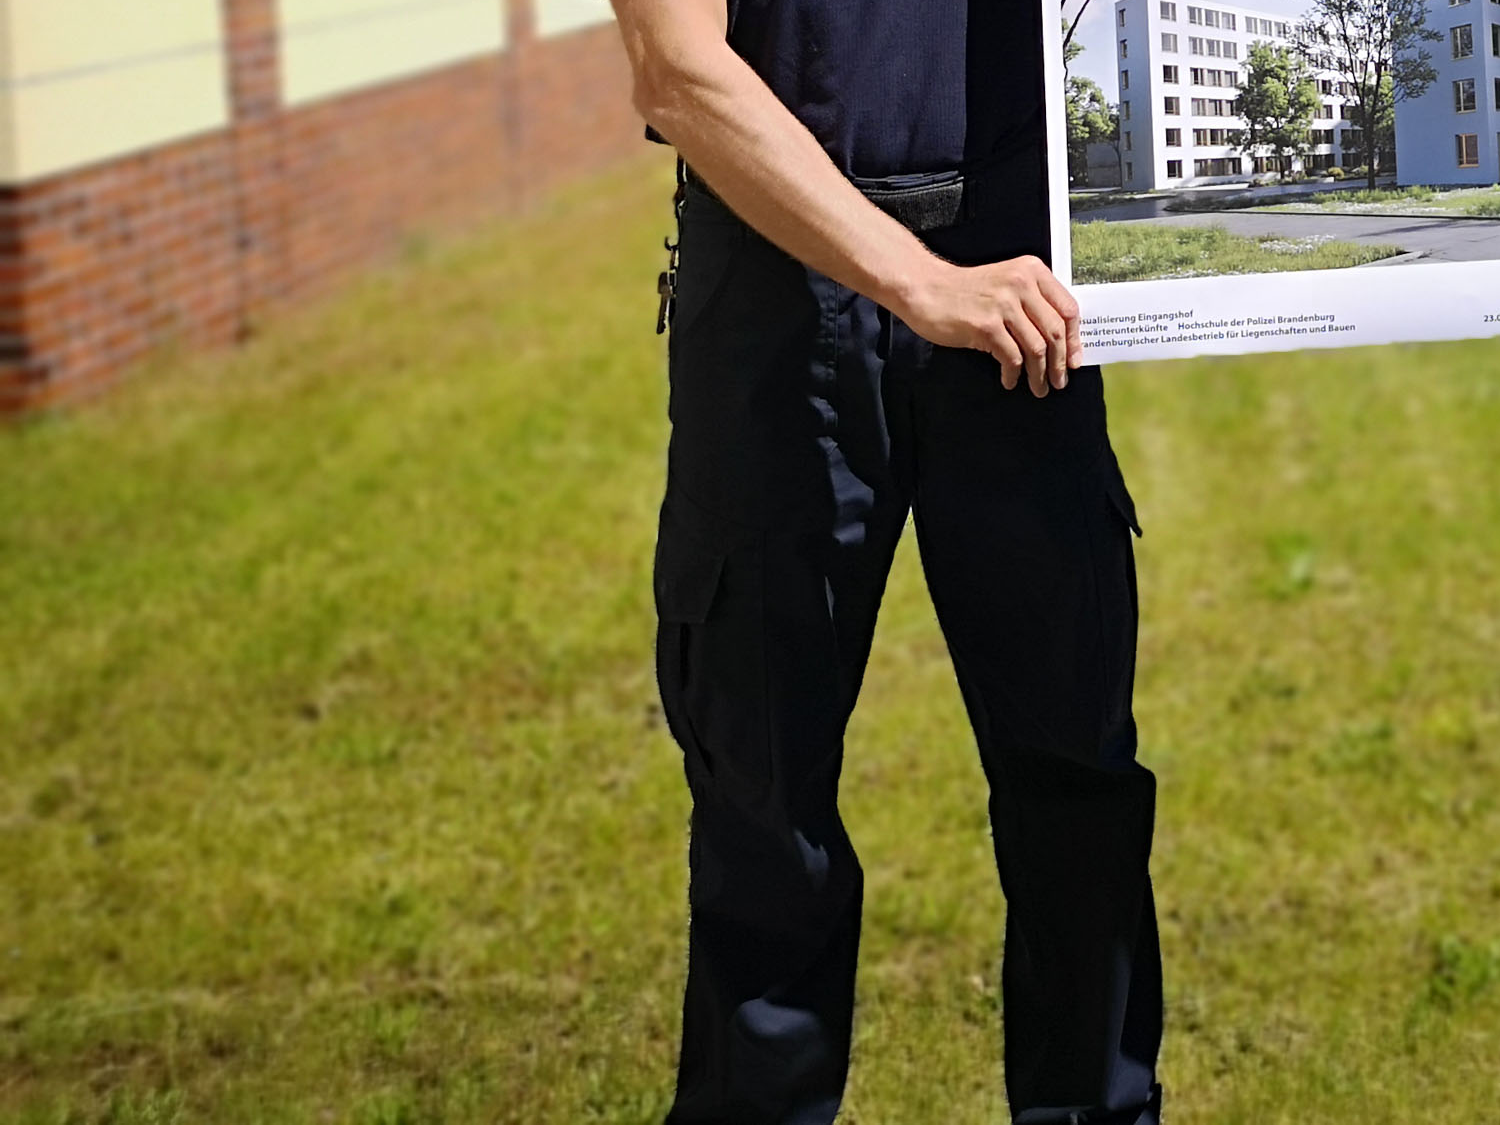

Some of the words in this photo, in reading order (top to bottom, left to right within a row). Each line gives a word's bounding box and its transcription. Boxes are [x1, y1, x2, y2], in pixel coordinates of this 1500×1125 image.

[1080, 314, 1136, 325] isualisierung
[1138, 310, 1194, 322] Eingangshof
[1080, 324, 1168, 336] nwärterunterkünfte
[1178, 319, 1229, 330] Hochschule
[1230, 317, 1245, 327] der
[1247, 316, 1276, 326] Polizei
[1278, 313, 1335, 324] Brandenburg
[1081, 336, 1159, 348] randenburgischer
[1161, 332, 1225, 343] Landesbetrieb
[1226, 330, 1239, 339] für
[1241, 326, 1307, 338] Liegenschaften
[1309, 325, 1327, 334] und
[1328, 323, 1356, 332] Bauen
